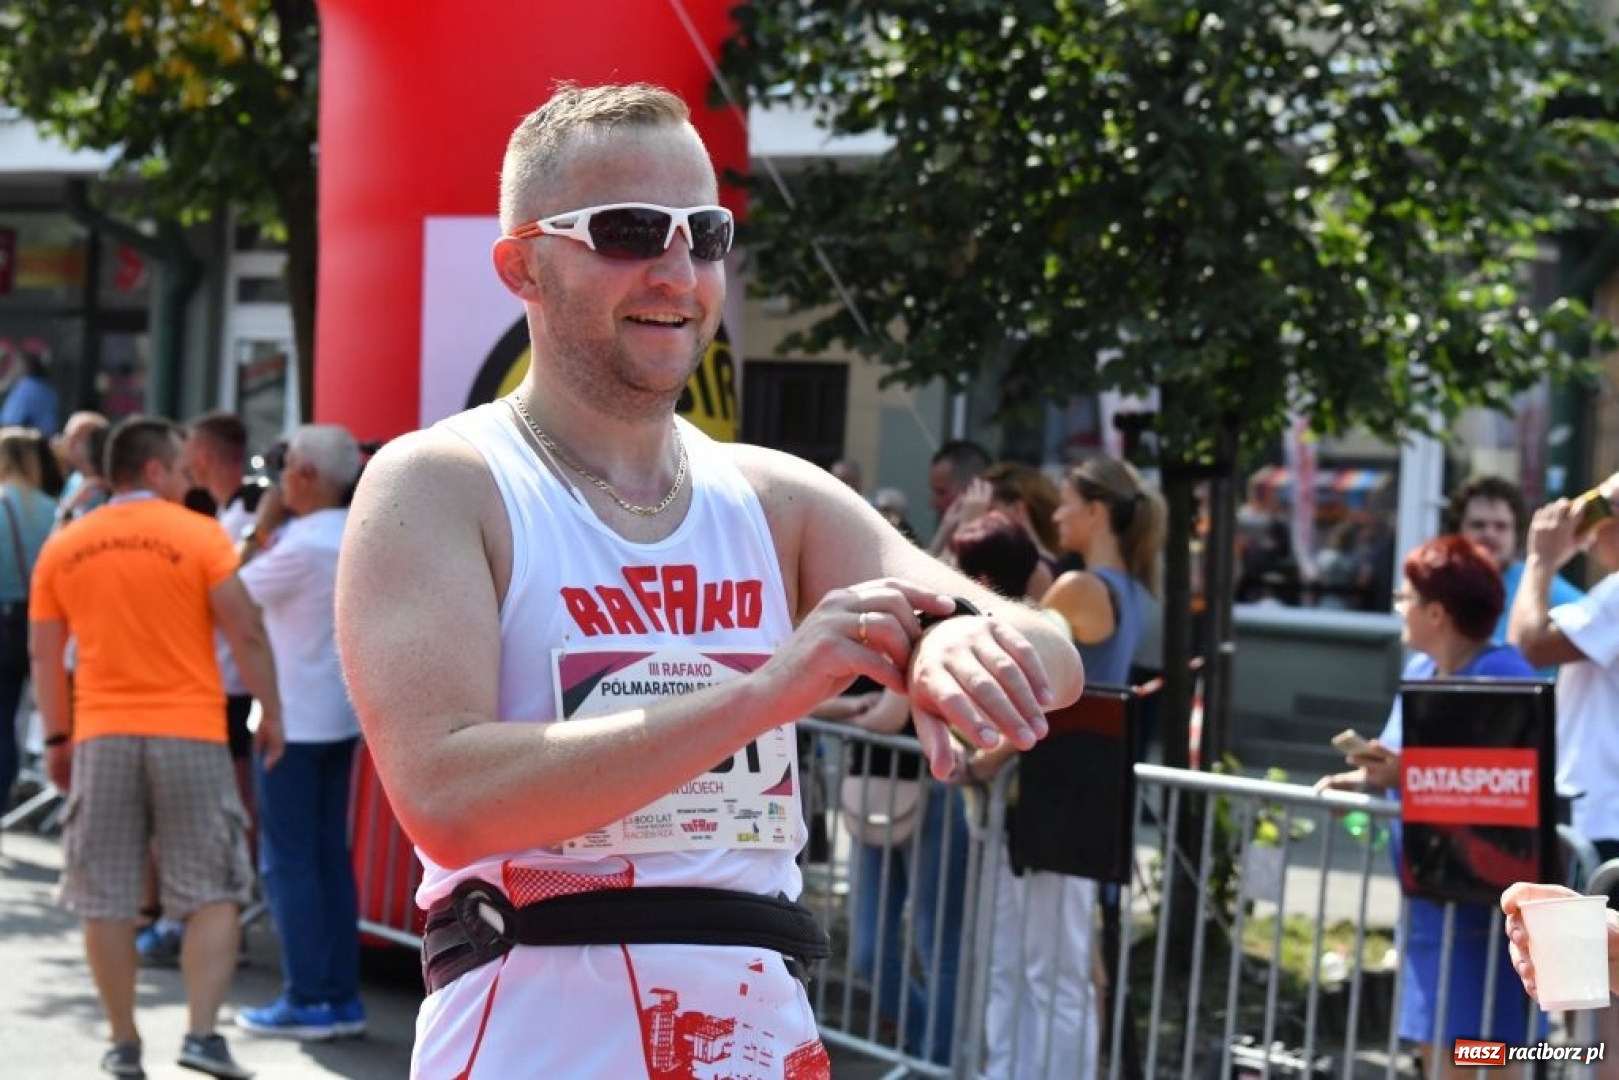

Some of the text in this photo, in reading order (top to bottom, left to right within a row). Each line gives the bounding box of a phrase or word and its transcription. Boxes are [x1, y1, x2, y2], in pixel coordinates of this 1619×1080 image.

[560, 564, 762, 637] RAFAKO
[661, 662, 713, 677] RAFAKO
[601, 678, 695, 696] PÓŁMARATON
[1406, 766, 1532, 794] DATASPORT
